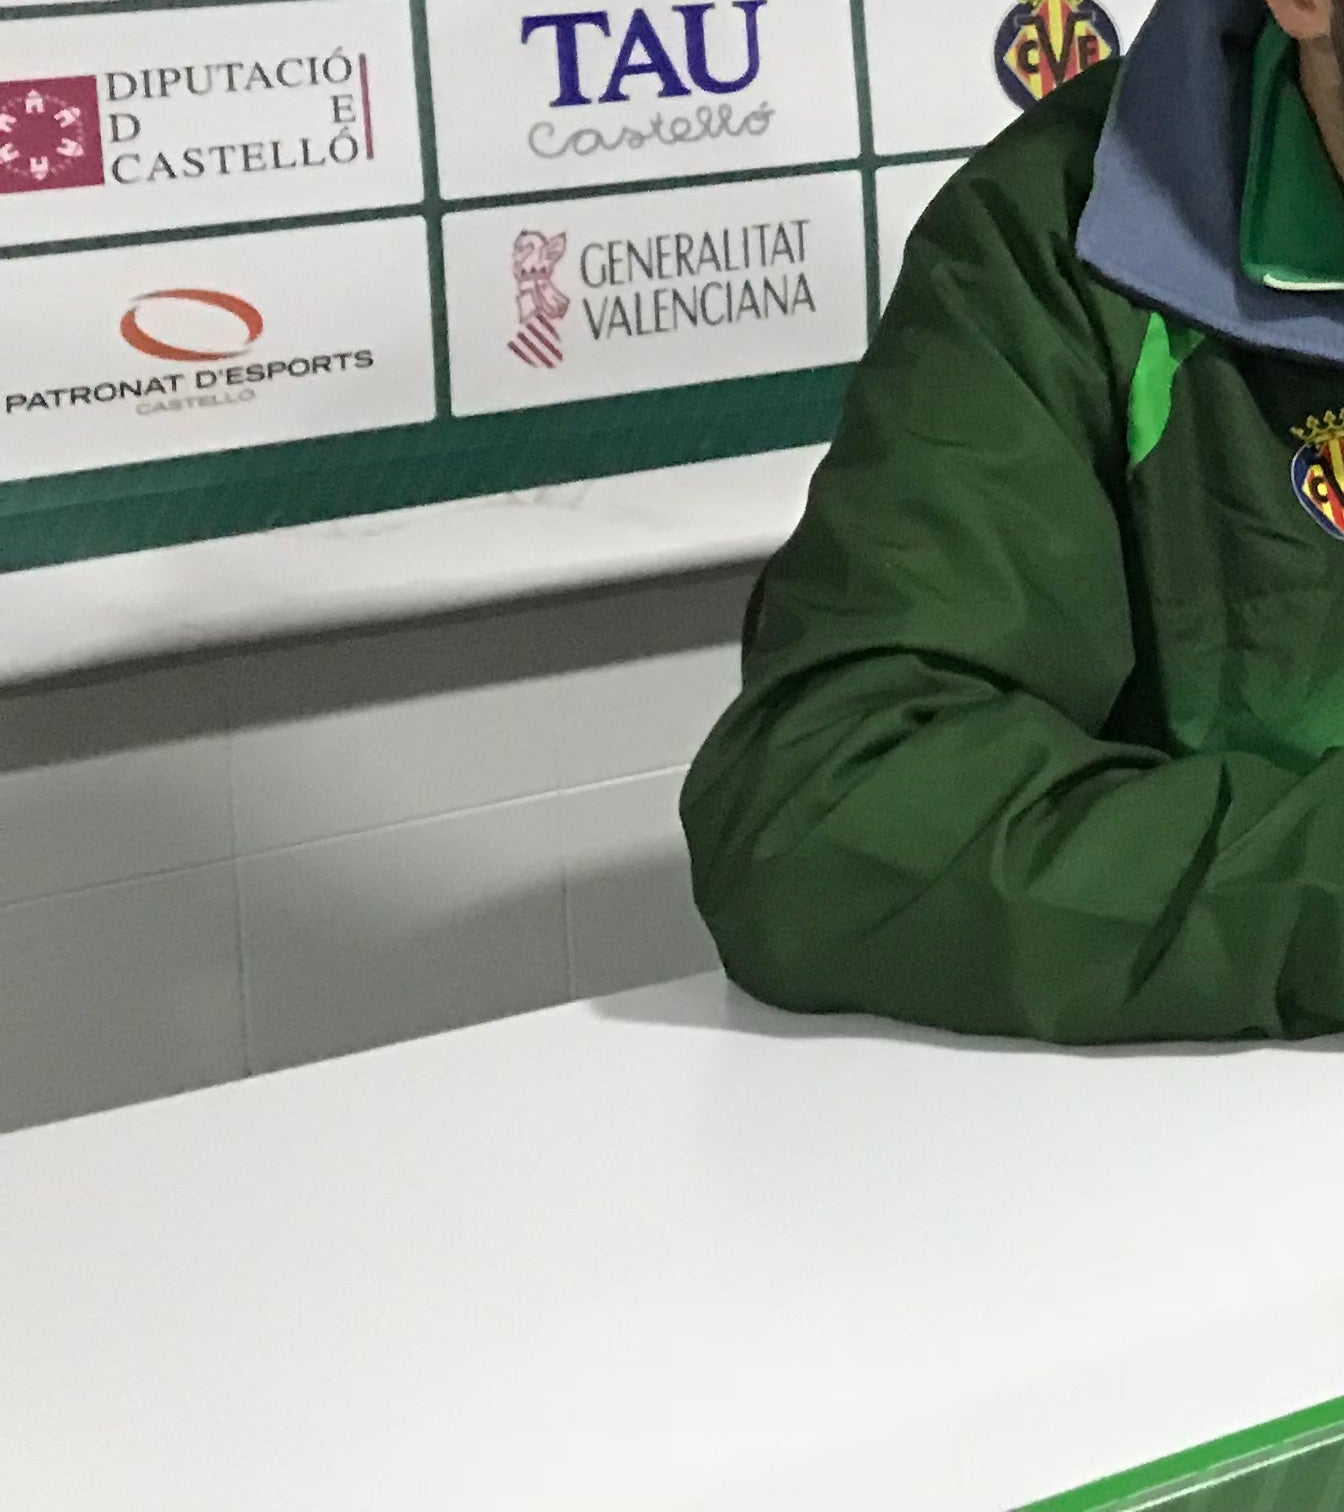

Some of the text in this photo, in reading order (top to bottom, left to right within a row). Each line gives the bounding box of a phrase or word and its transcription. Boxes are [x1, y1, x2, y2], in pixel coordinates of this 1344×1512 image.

[104, 47, 354, 102] DIPUTACIÓ
[521, 0, 768, 108] TAU
[112, 130, 359, 186] CASTELLÓ
[527, 101, 775, 159] Castelló
[580, 219, 810, 289] GENERALITAT
[581, 276, 816, 342] VALENCIANA
[5, 349, 375, 414] PATRONAT D'ESPORTS
